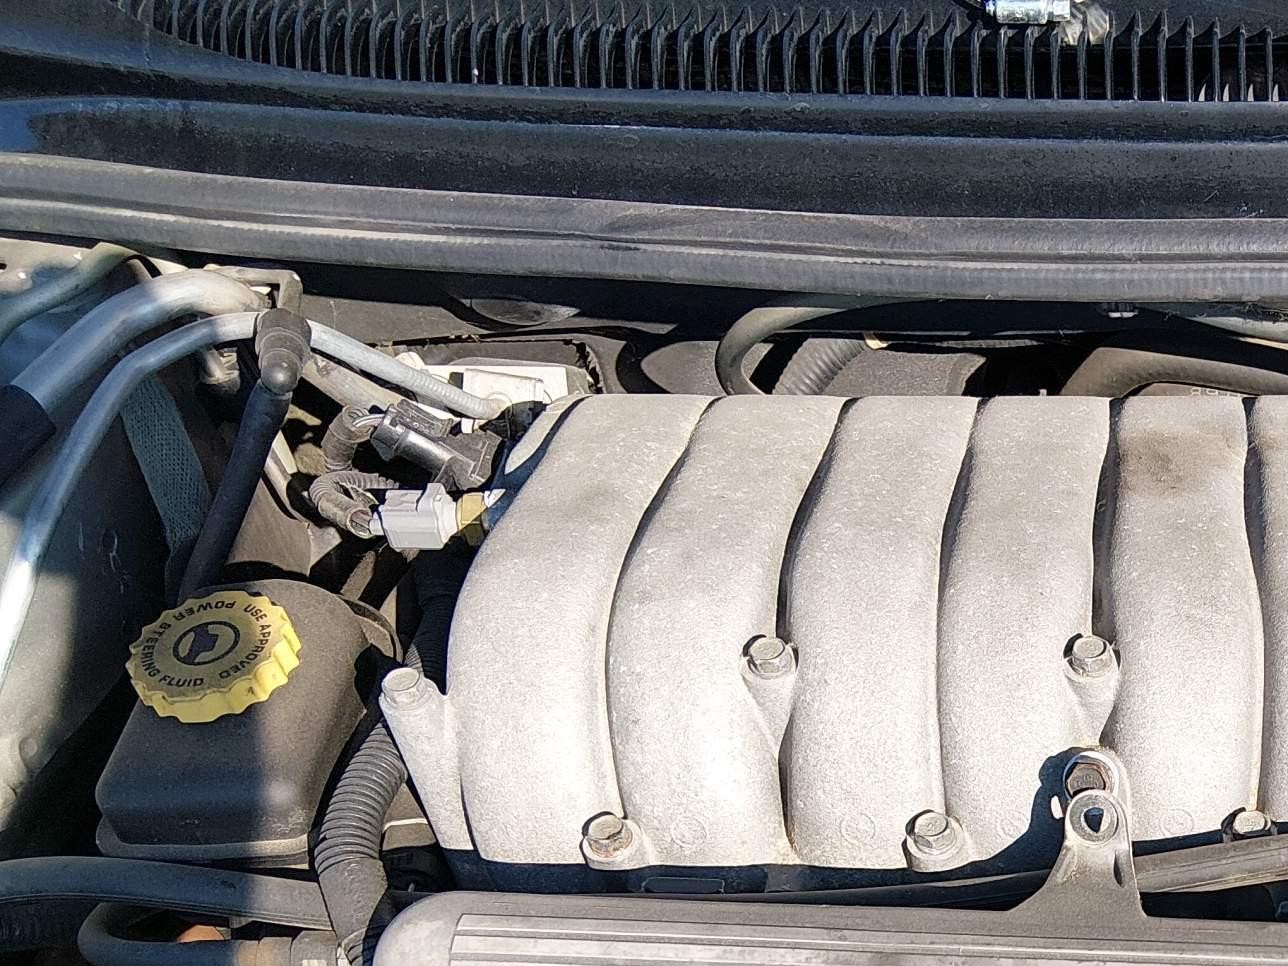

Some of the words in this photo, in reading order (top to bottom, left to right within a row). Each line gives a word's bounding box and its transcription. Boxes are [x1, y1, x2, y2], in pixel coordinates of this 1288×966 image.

[172, 600, 237, 621] POWER
[243, 603, 267, 622] USE
[140, 622, 172, 679] STEERING
[218, 623, 273, 680] APPROVED
[158, 675, 205, 688] FLUID
